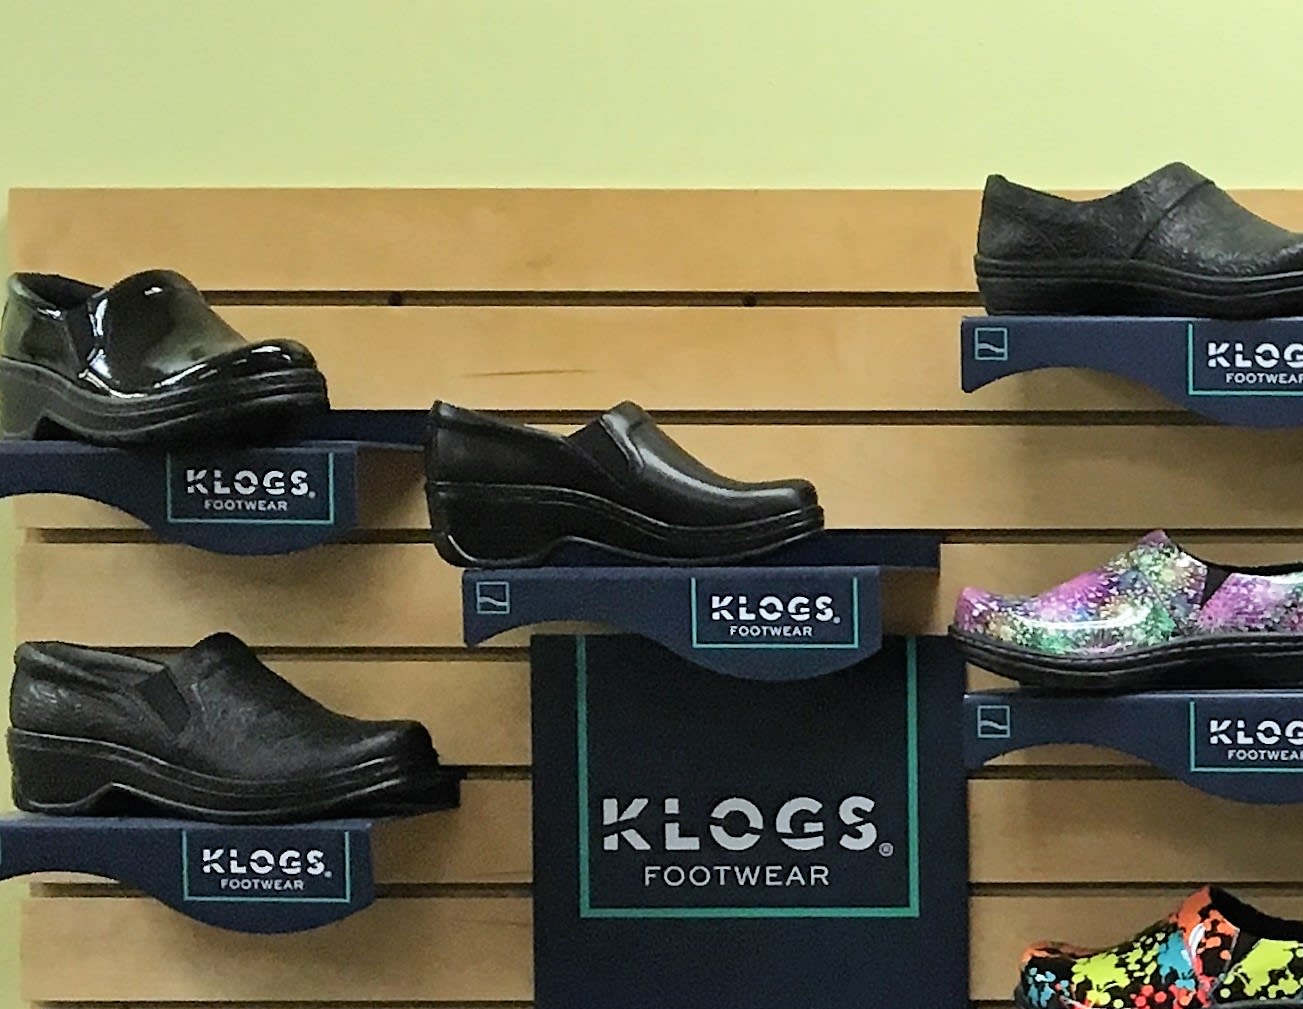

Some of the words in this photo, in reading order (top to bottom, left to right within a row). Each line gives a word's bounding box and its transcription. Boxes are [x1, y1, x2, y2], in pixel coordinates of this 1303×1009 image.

[186, 469, 309, 497] KLOGS
[204, 500, 288, 511] FOOTWEAR
[711, 595, 833, 622] KLOGS
[730, 625, 813, 637] FOOTWEAR
[603, 796, 877, 851] KLOGS
[202, 849, 324, 876] KLOGS
[220, 879, 304, 890] FOOTWEAR
[644, 865, 829, 886] FOOTWEAR
